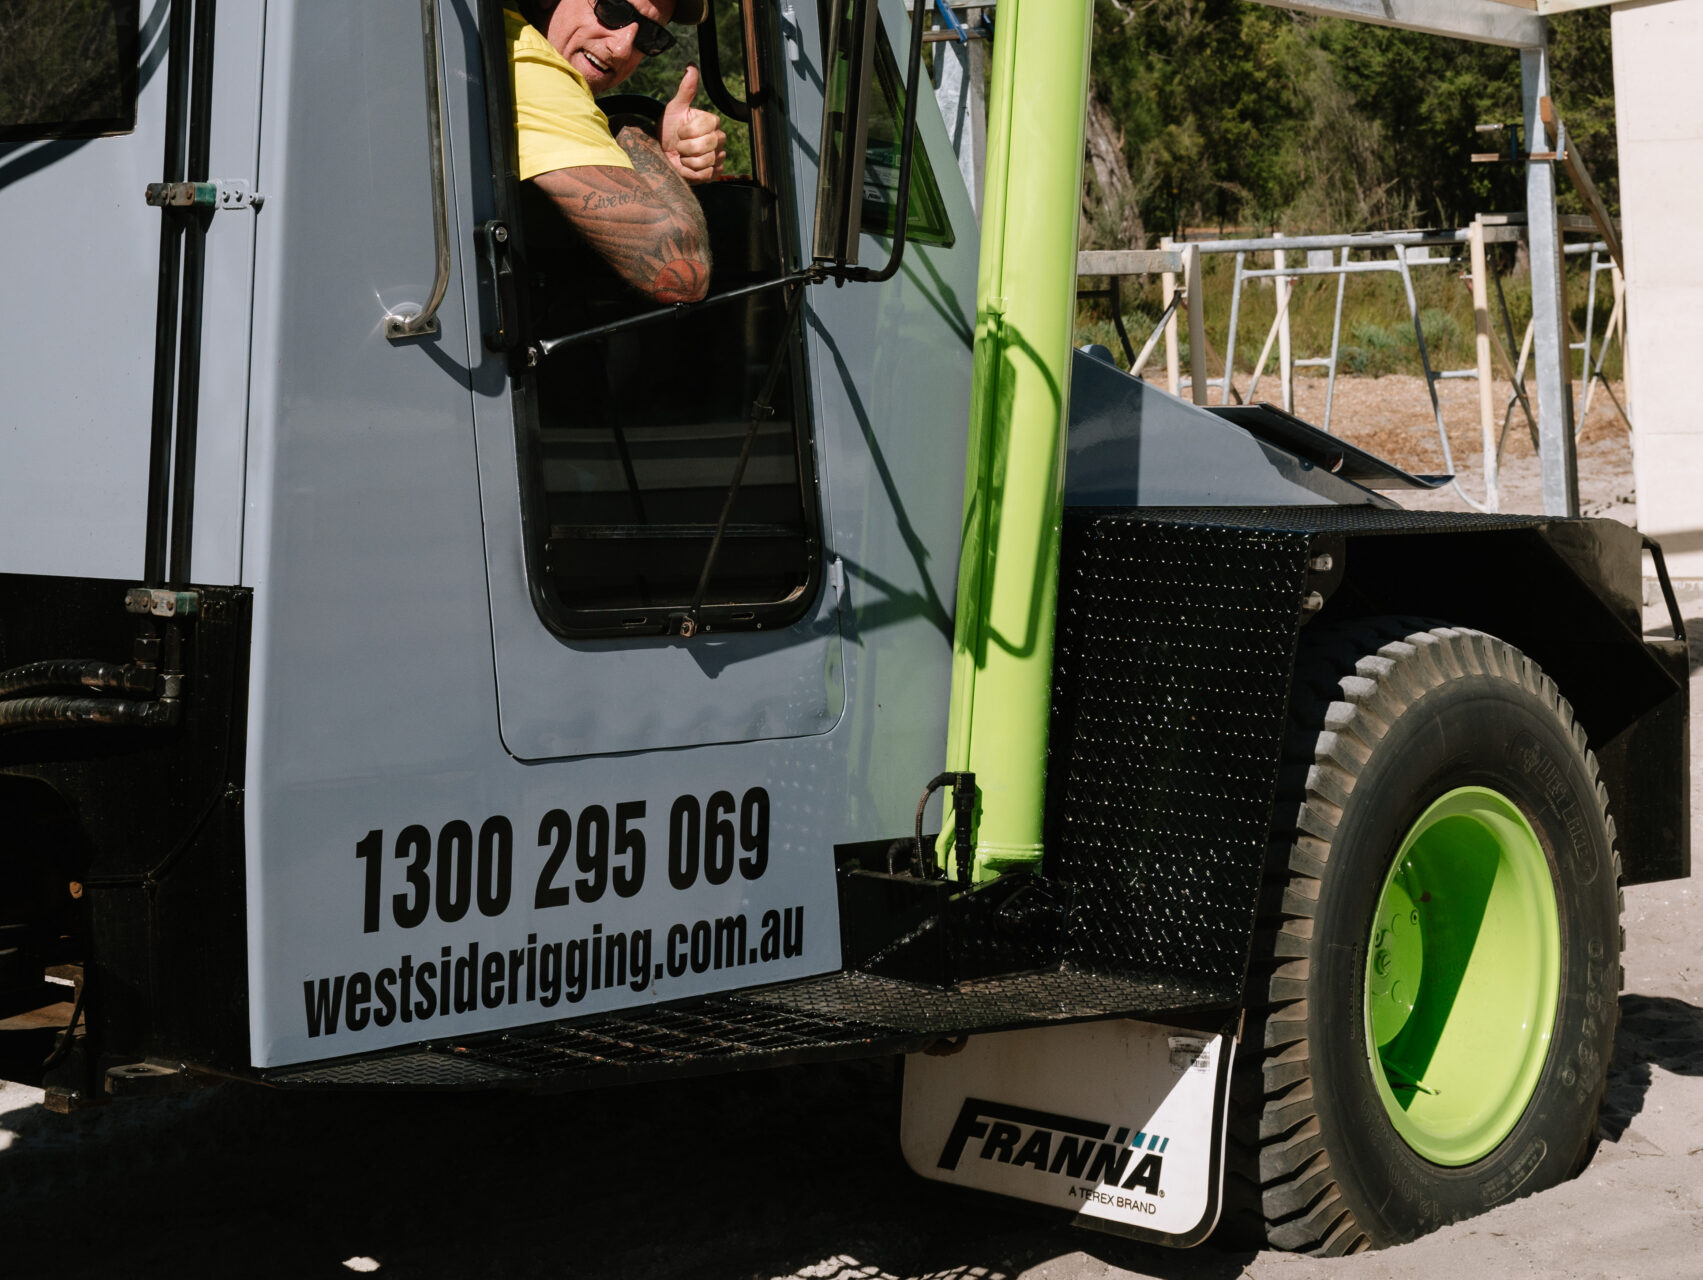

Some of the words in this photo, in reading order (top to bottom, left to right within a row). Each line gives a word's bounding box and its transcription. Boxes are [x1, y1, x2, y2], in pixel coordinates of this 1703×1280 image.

[355, 815, 514, 934] 1300
[534, 799, 647, 910] 295
[668, 786, 770, 891] 069
[304, 906, 804, 1039] westsiderigging.com.au
[937, 1097, 1164, 1197] FRANNA
[1068, 1185, 1077, 1197] A
[1079, 1187, 1115, 1206] TEREX
[1116, 1198, 1157, 1214] BRAND
